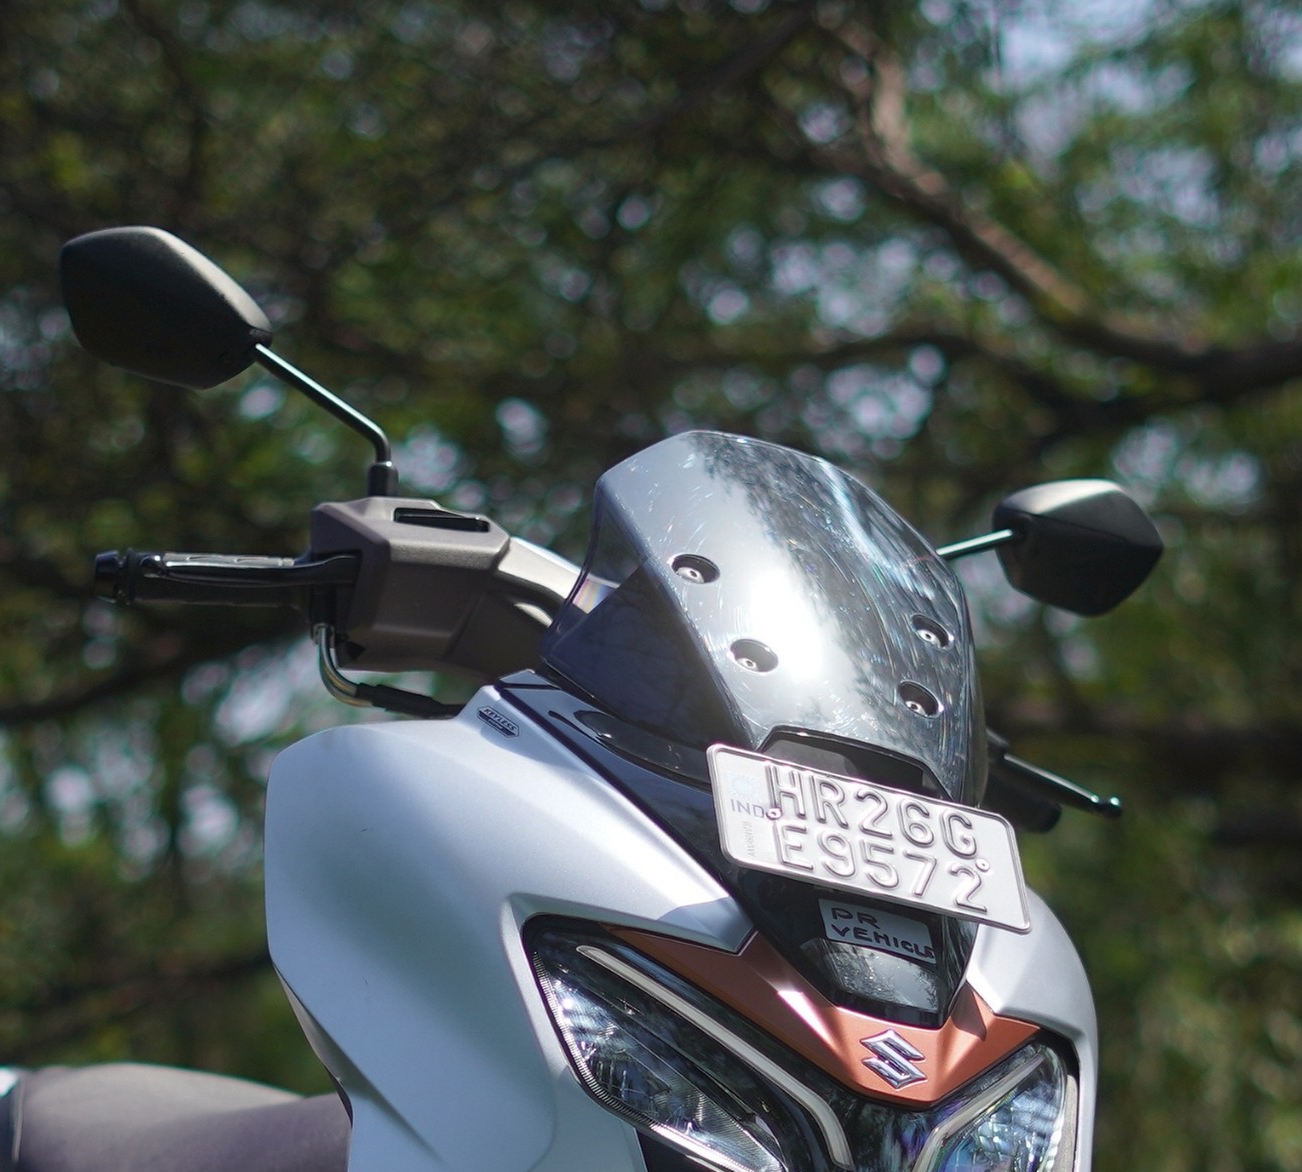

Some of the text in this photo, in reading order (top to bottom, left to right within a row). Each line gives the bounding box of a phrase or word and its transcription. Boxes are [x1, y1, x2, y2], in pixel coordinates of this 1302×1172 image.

[483, 708, 517, 731] KEYLESS
[731, 799, 765, 818] IND
[766, 764, 977, 860] HR26G
[772, 822, 987, 914] E9572
[831, 908, 880, 929] PR
